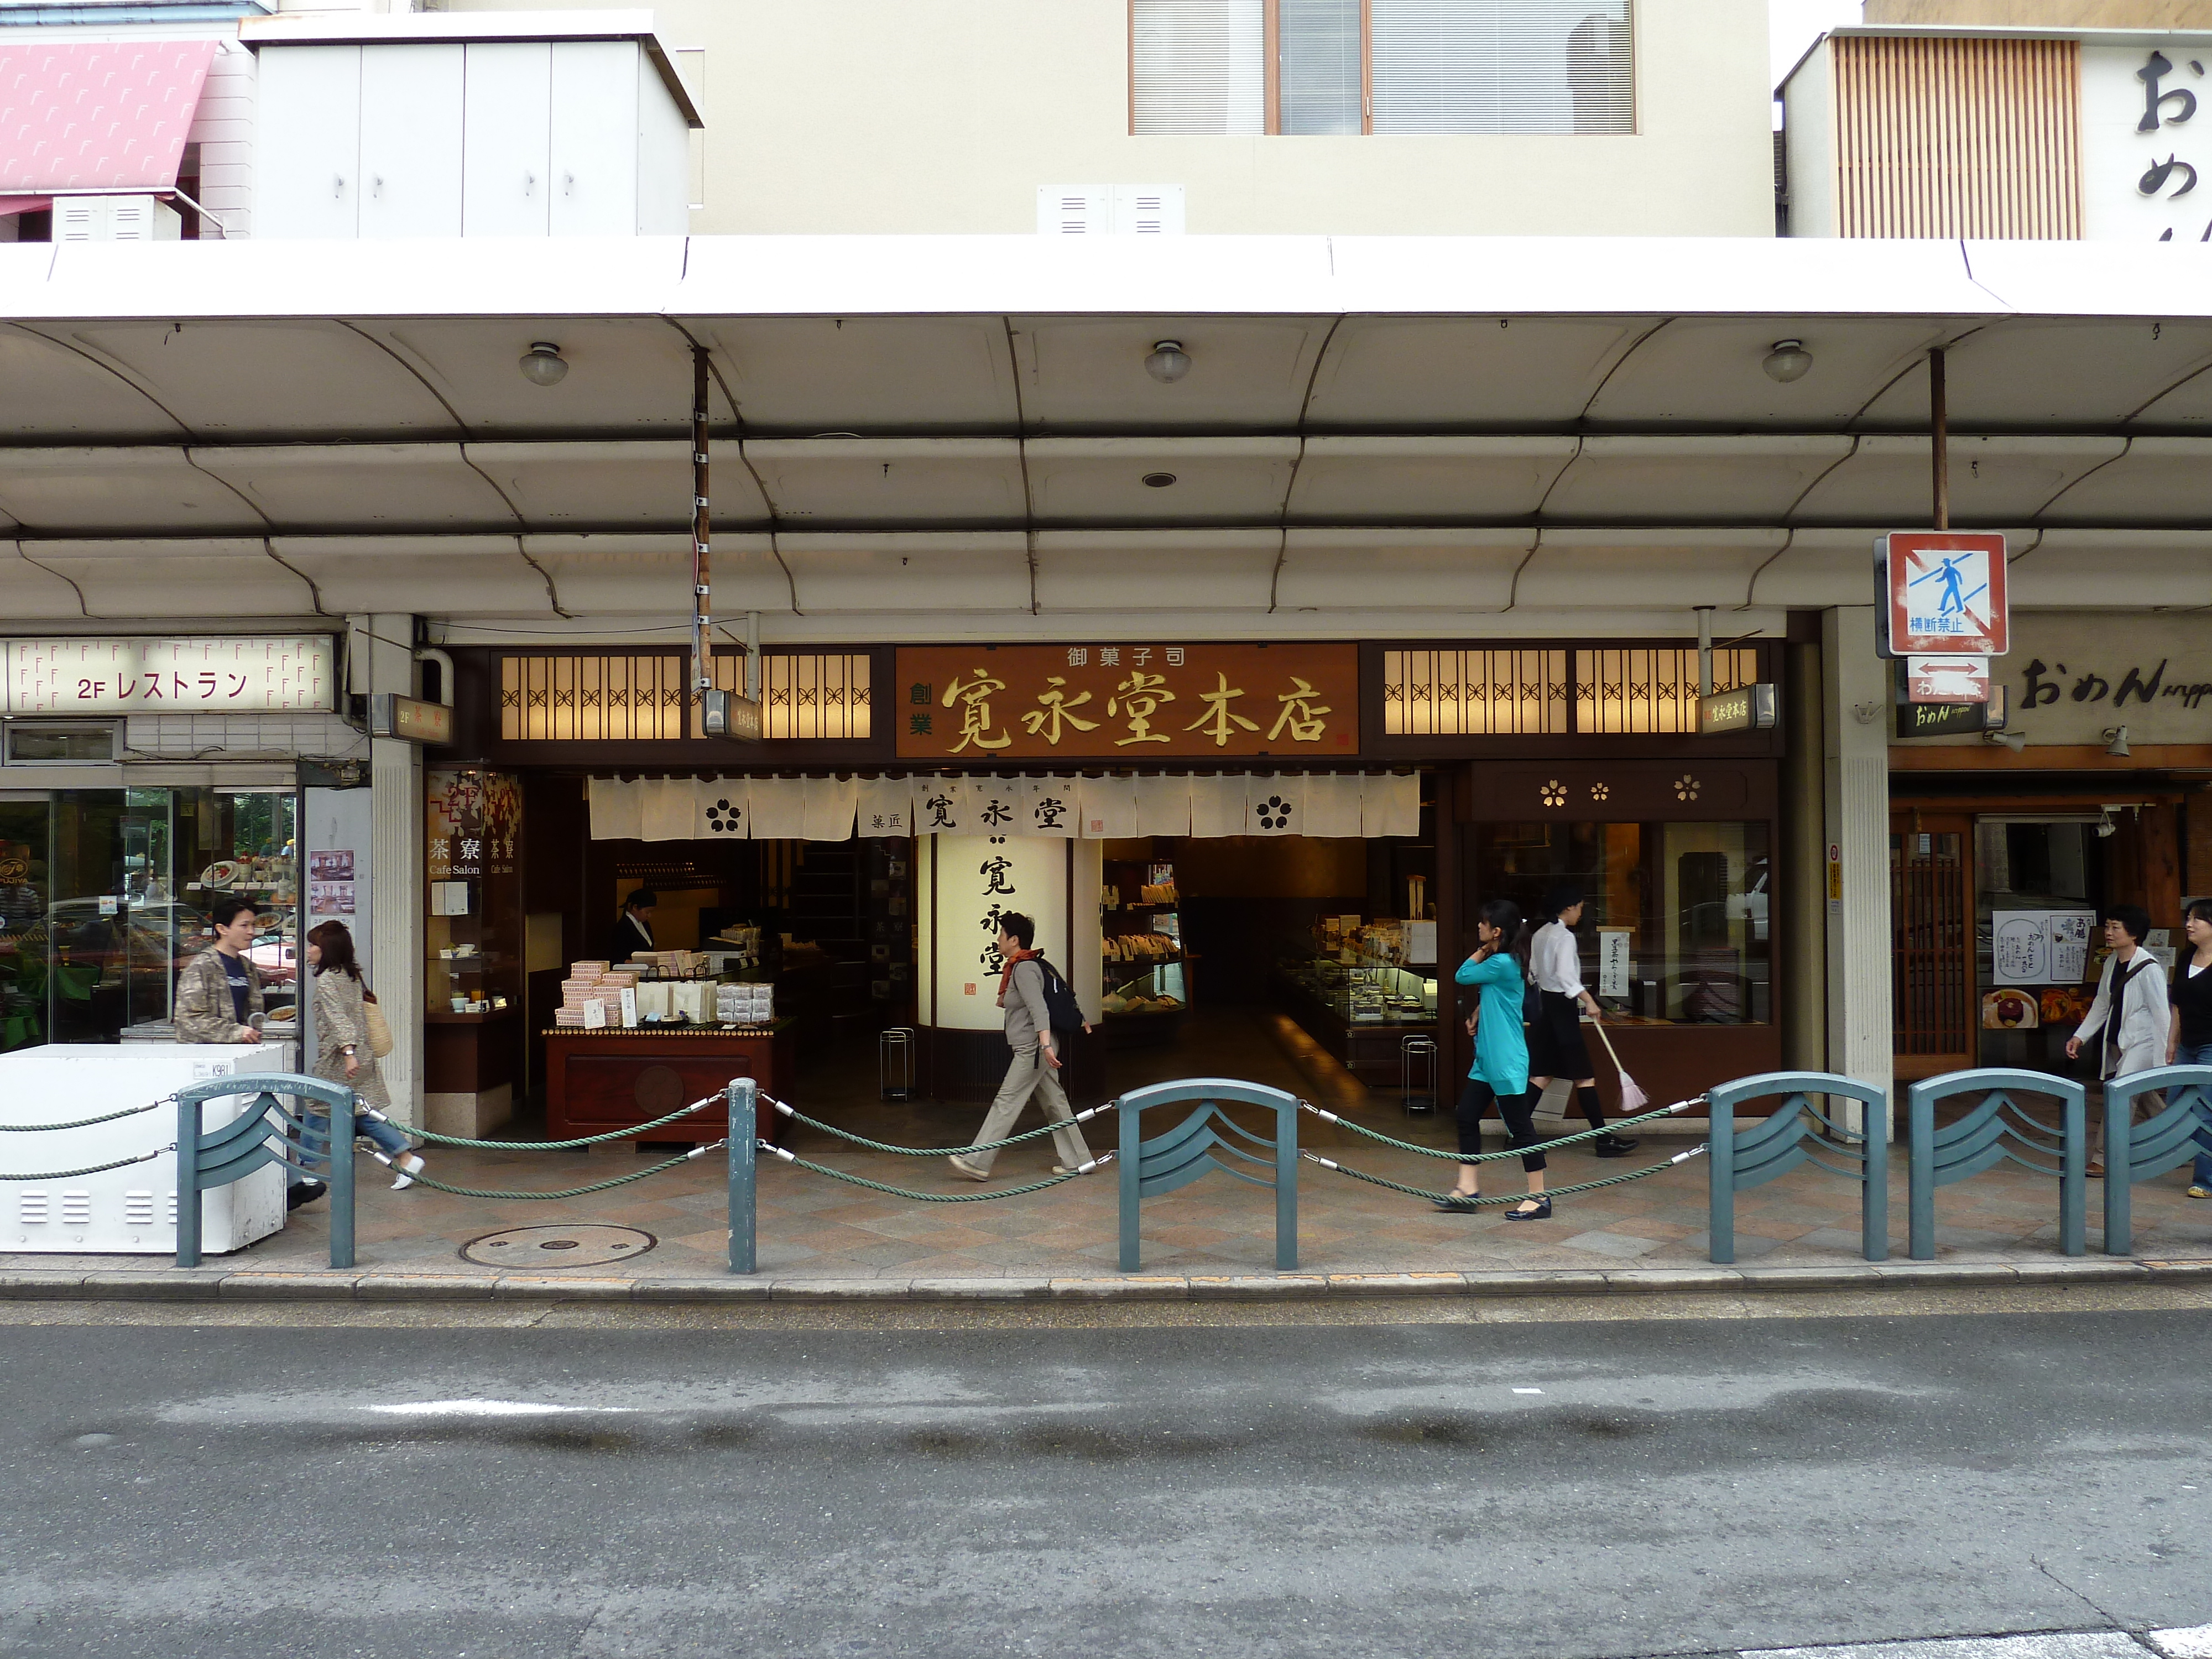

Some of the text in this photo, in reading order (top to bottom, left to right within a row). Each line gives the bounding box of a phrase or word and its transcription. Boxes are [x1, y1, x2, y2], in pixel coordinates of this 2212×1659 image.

[2135, 50, 2212, 241] おめ
[1910, 617, 1964, 633] 横断禁止
[1067, 646, 1185, 667] 御菓子司
[77, 671, 247, 699] 2F レストラン
[2162, 683, 2212, 708] nipp
[400, 711, 410, 724] 2F
[910, 682, 932, 735] 創業
[941, 668, 1332, 754] 寛永堂本店
[447, 786, 479, 806] 2F
[922, 784, 1071, 794] 創業寛永年間
[872, 813, 902, 829] 菓匠
[926, 794, 1067, 830] 寛永堂
[430, 838, 481, 859] 茶寮
[430, 865, 480, 874] Cafe Salon
[979, 855, 1016, 977] 寛永堂
